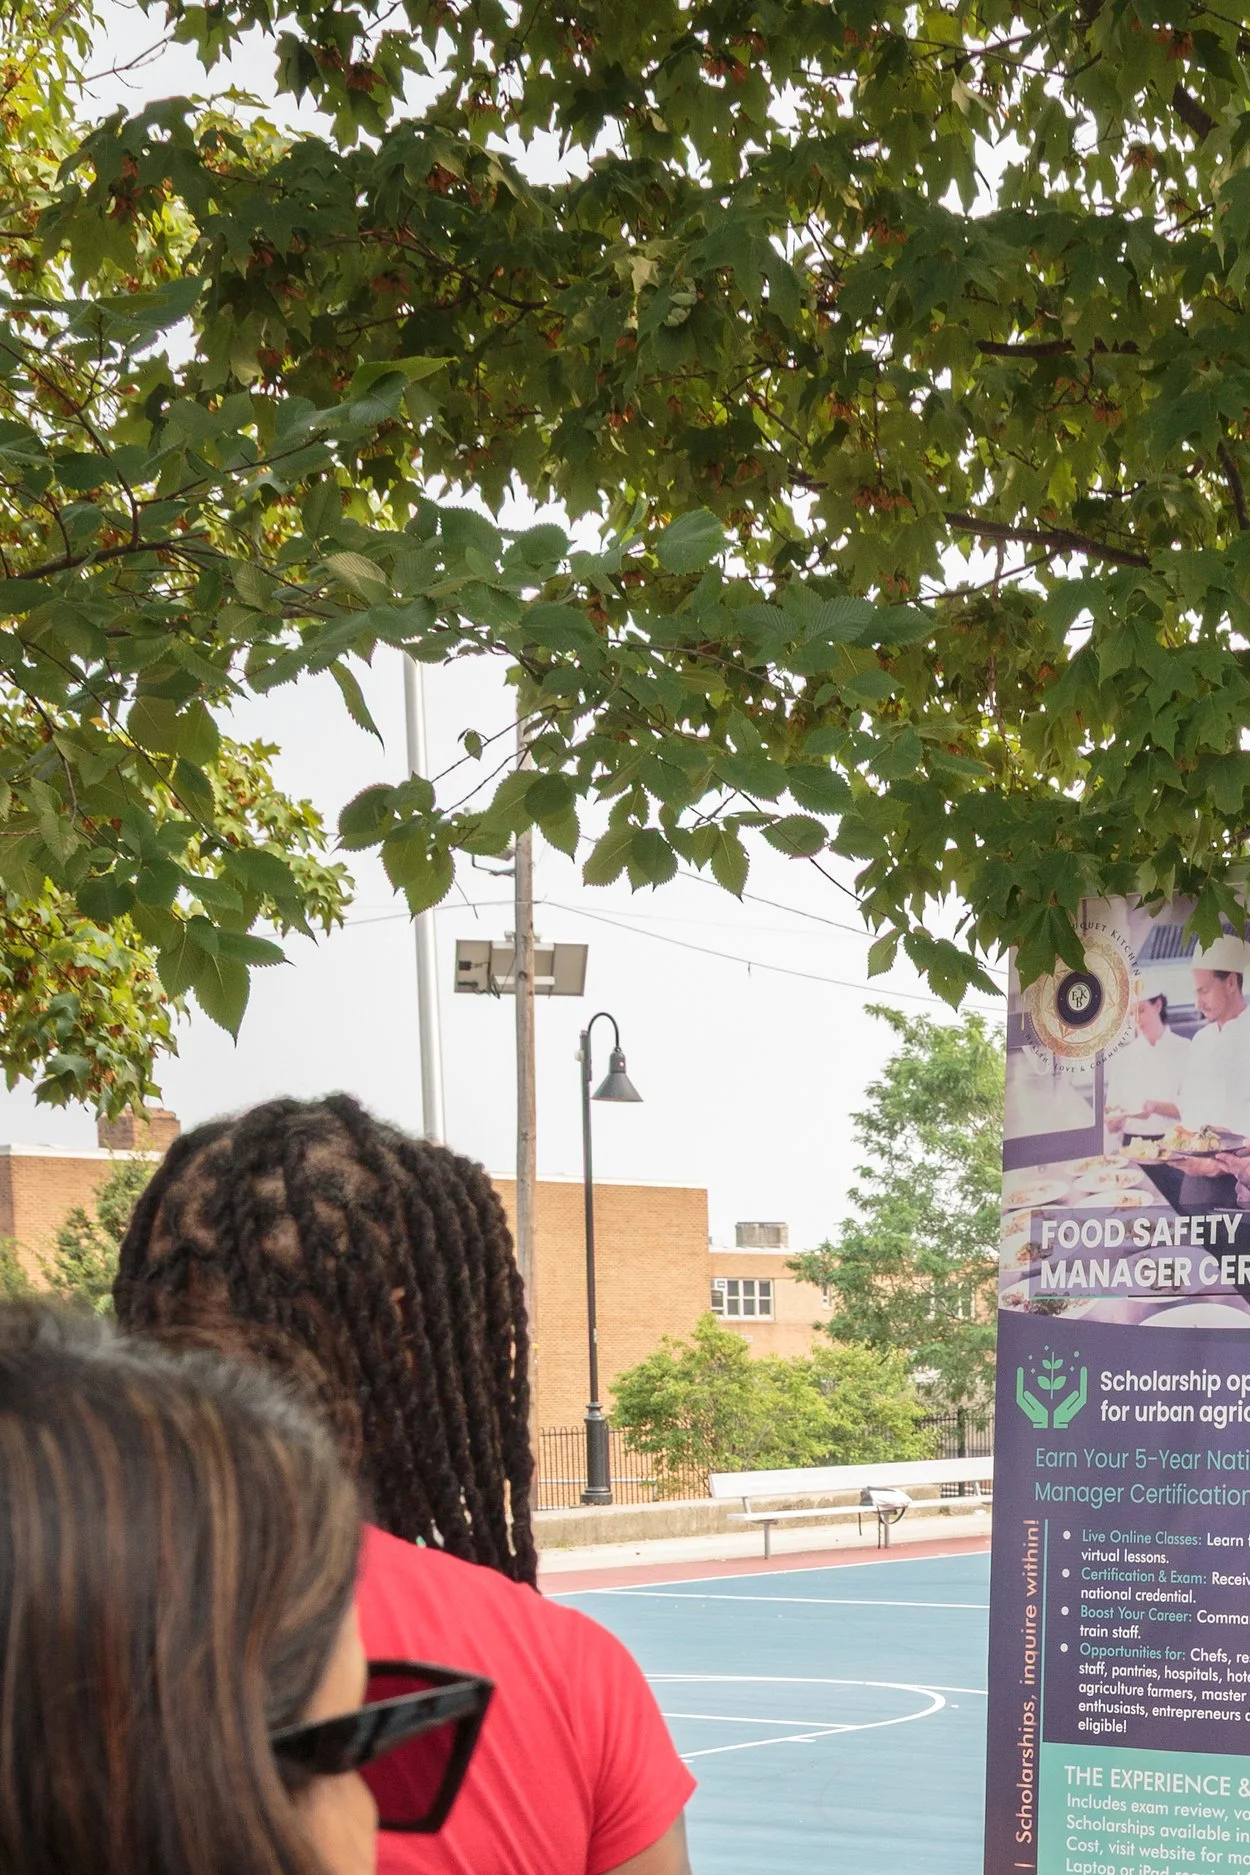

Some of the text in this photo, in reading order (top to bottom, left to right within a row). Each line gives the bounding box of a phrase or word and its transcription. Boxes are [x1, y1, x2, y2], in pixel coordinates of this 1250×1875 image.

[1110, 929, 1141, 976] KITCHEN
[1090, 1025, 1133, 1069] COMMUNITY
[1042, 1214, 1243, 1249] FOOD SAFETY
[1040, 1257, 1192, 1288] MANAGER
[1101, 1369, 1221, 1398] Scholarship
[1101, 1400, 1130, 1421] for
[1135, 1401, 1194, 1422] urban
[1036, 1448, 1077, 1467] Earn
[1084, 1449, 1129, 1468] Your
[1136, 1449, 1201, 1469] 5-Year
[1036, 1482, 1124, 1509] Manager
[1083, 1530, 1105, 1542] Live
[1110, 1530, 1151, 1544] Online
[1156, 1531, 1201, 1545] Classes:
[1207, 1532, 1243, 1546] Learn
[1022, 1519, 1039, 1597] within!
[1082, 1548, 1169, 1563] virtual lessons.
[1082, 1567, 1154, 1582] Certification
[1159, 1570, 1166, 1582] &
[1171, 1571, 1206, 1584] Exam:
[1081, 1586, 1196, 1603] national credential.
[1081, 1605, 1114, 1618] Boost
[1118, 1607, 1145, 1620] Your
[1149, 1608, 1191, 1622] Career:
[1080, 1624, 1140, 1638] train staff.
[1019, 1604, 1039, 1685] inquire
[1080, 1643, 1161, 1659] Opportunities
[1165, 1646, 1185, 1660] for:
[1191, 1648, 1231, 1665] Chefs,
[1079, 1661, 1107, 1677] staff,
[1112, 1664, 1160, 1680] pantries,
[1165, 1665, 1222, 1684] hospitals,
[1079, 1681, 1144, 1696] agriculture
[1147, 1683, 1196, 1701] farmers,
[1202, 1690, 1246, 1701] master
[1078, 1717, 1126, 1734] eligible!
[1015, 1695, 1037, 1844] Scholarships,
[1064, 1766, 1102, 1786] THE
[1111, 1769, 1230, 1796] EXPERIENCE
[1068, 1793, 1126, 1811] Includes
[1131, 1802, 1168, 1814] exam
[1175, 1803, 1228, 1821] review,
[1066, 1836, 1103, 1855] Cost,
[1108, 1840, 1135, 1856] visit
[1139, 1844, 1195, 1860] website
[1200, 1846, 1223, 1862] for
